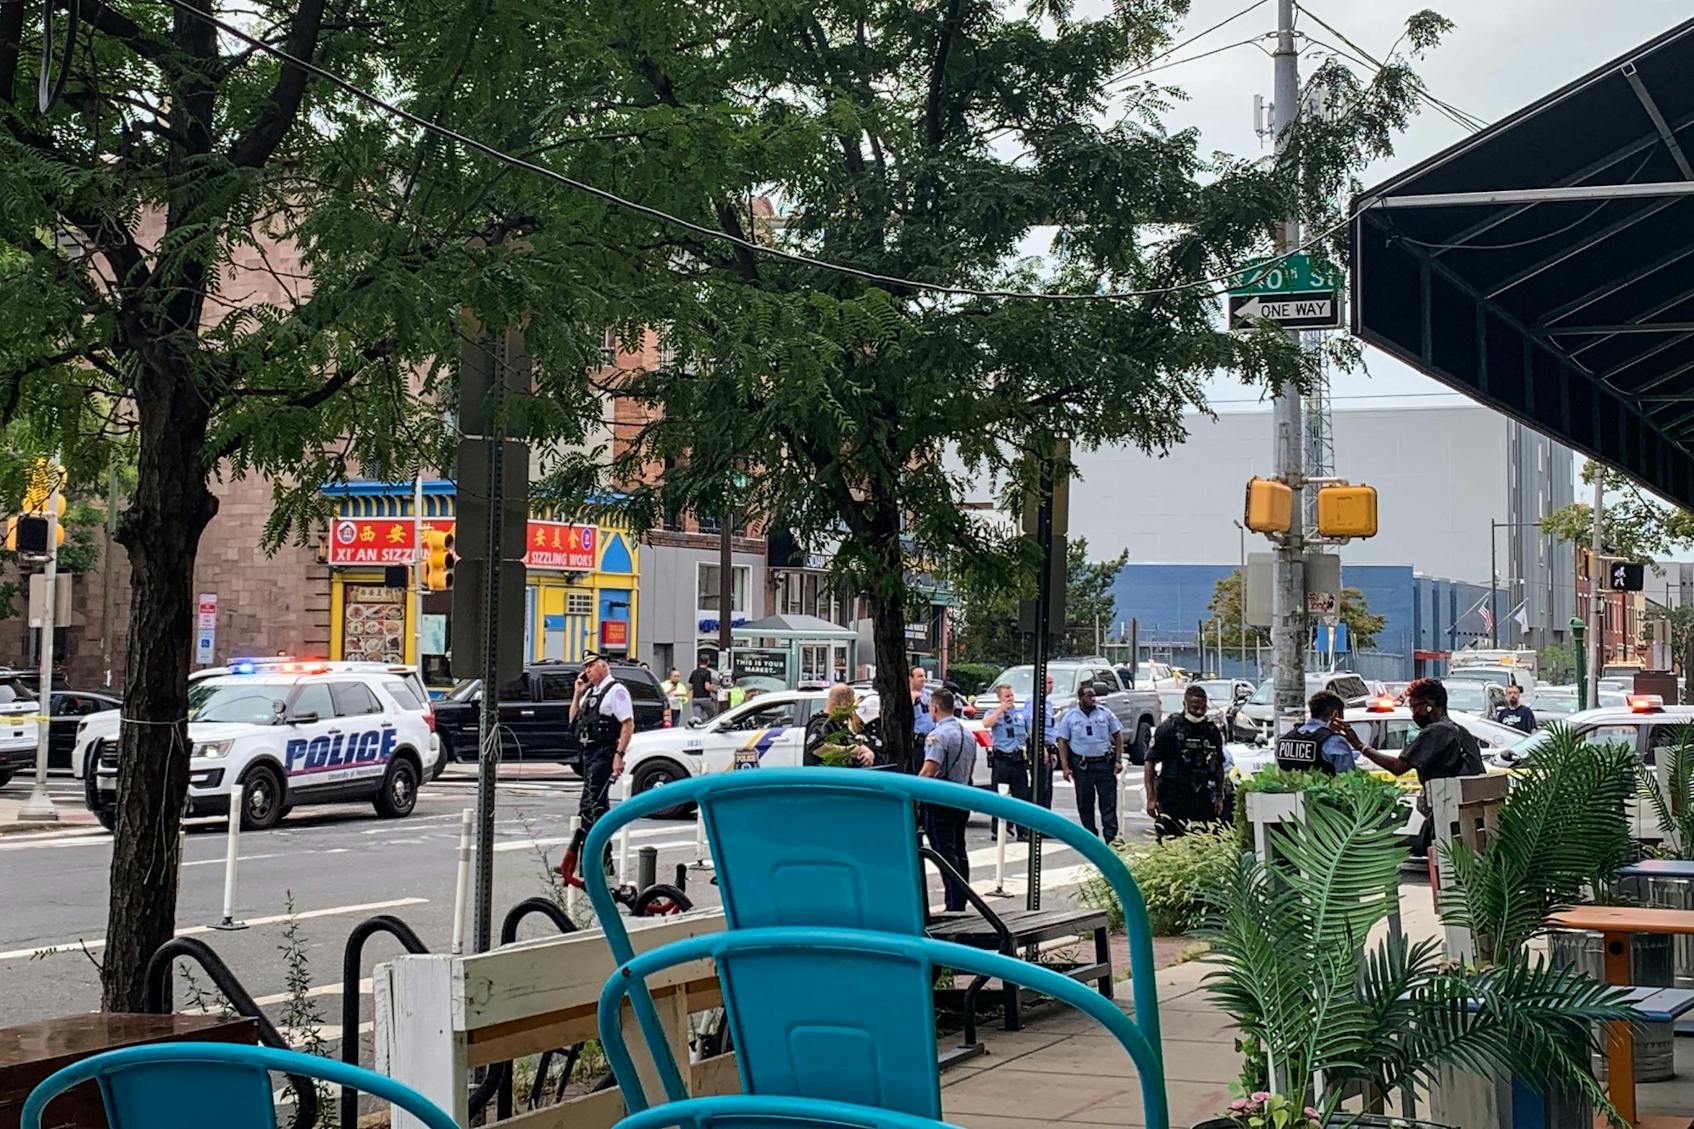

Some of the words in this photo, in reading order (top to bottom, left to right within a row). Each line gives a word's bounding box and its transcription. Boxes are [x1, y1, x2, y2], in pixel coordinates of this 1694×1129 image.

[1261, 304, 1290, 318] ONE
[1296, 302, 1326, 316] WAY
[360, 522, 431, 544] 西安
[531, 551, 567, 565] SIZZLING
[569, 553, 593, 567] WOKS
[763, 660, 784, 668] YOUR
[284, 728, 397, 771] POLICE
[1279, 742, 1312, 759] POLICE
